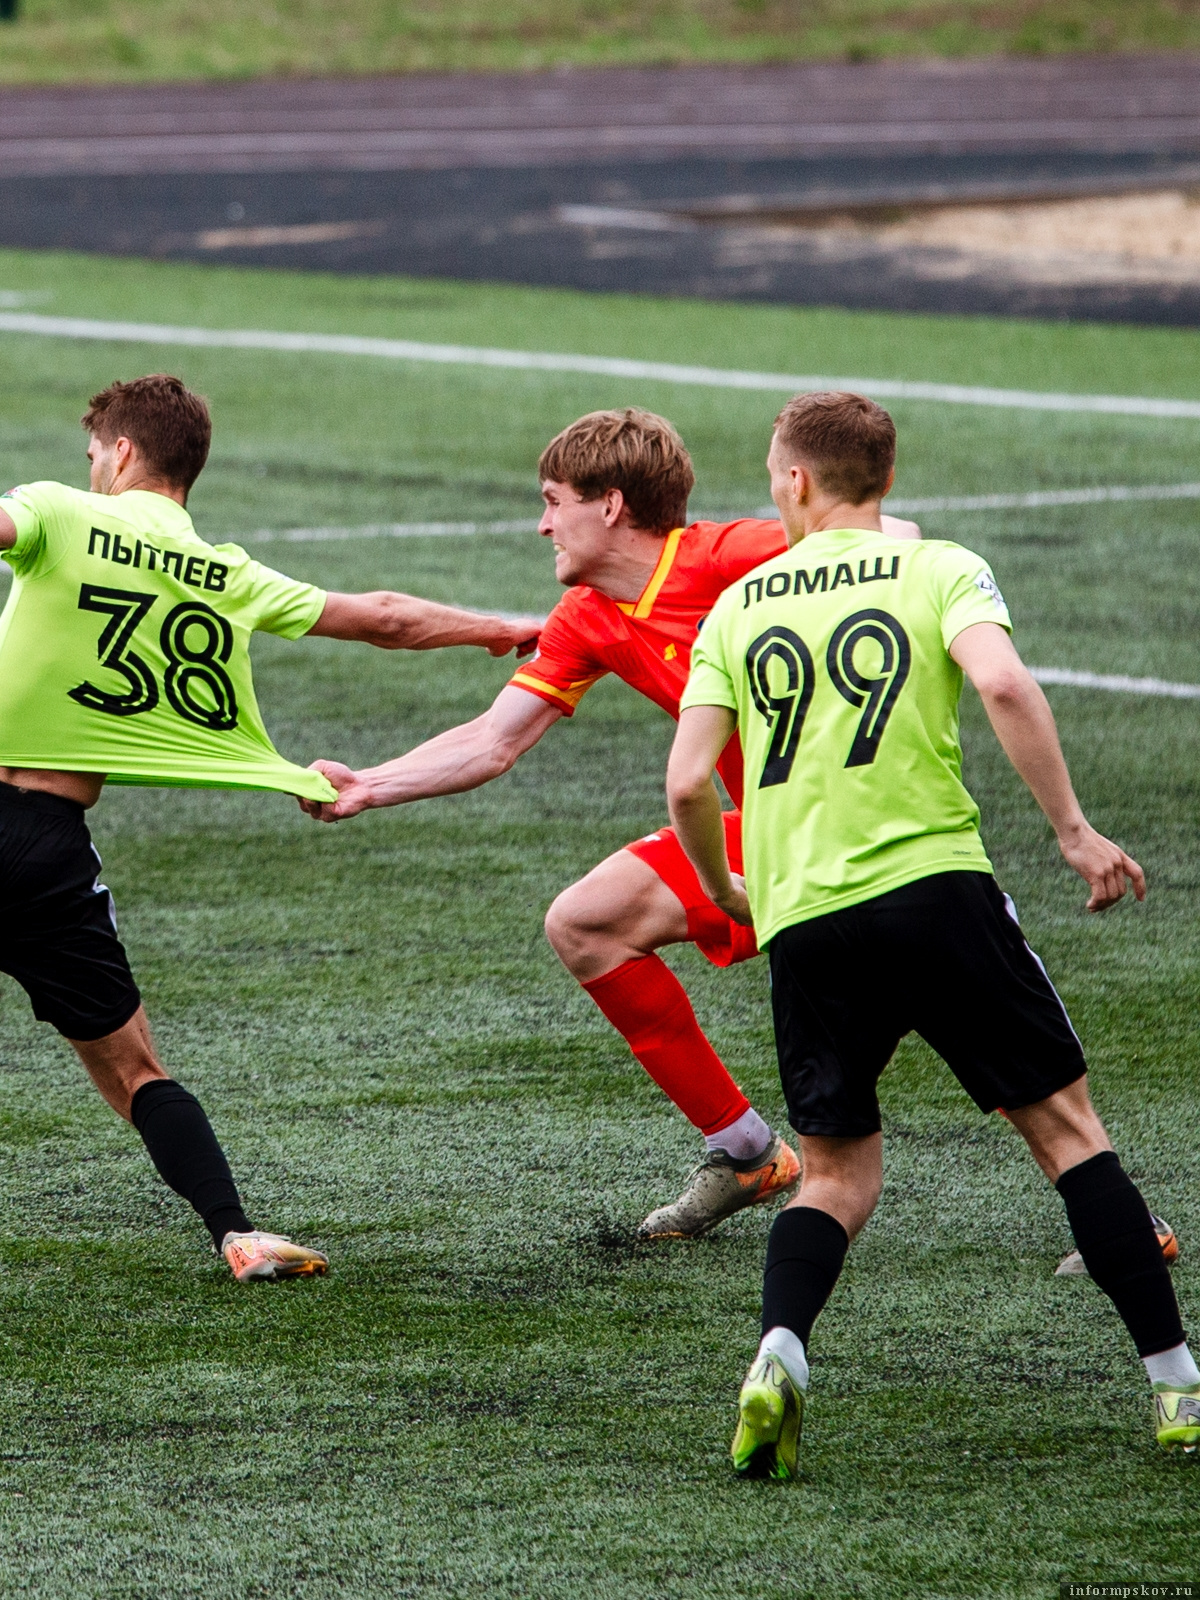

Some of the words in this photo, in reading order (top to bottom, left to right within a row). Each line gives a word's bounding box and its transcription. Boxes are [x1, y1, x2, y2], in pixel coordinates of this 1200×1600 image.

[67, 582, 239, 731] 38
[743, 555, 900, 609] ЛОМАШ
[745, 608, 911, 790] 99
